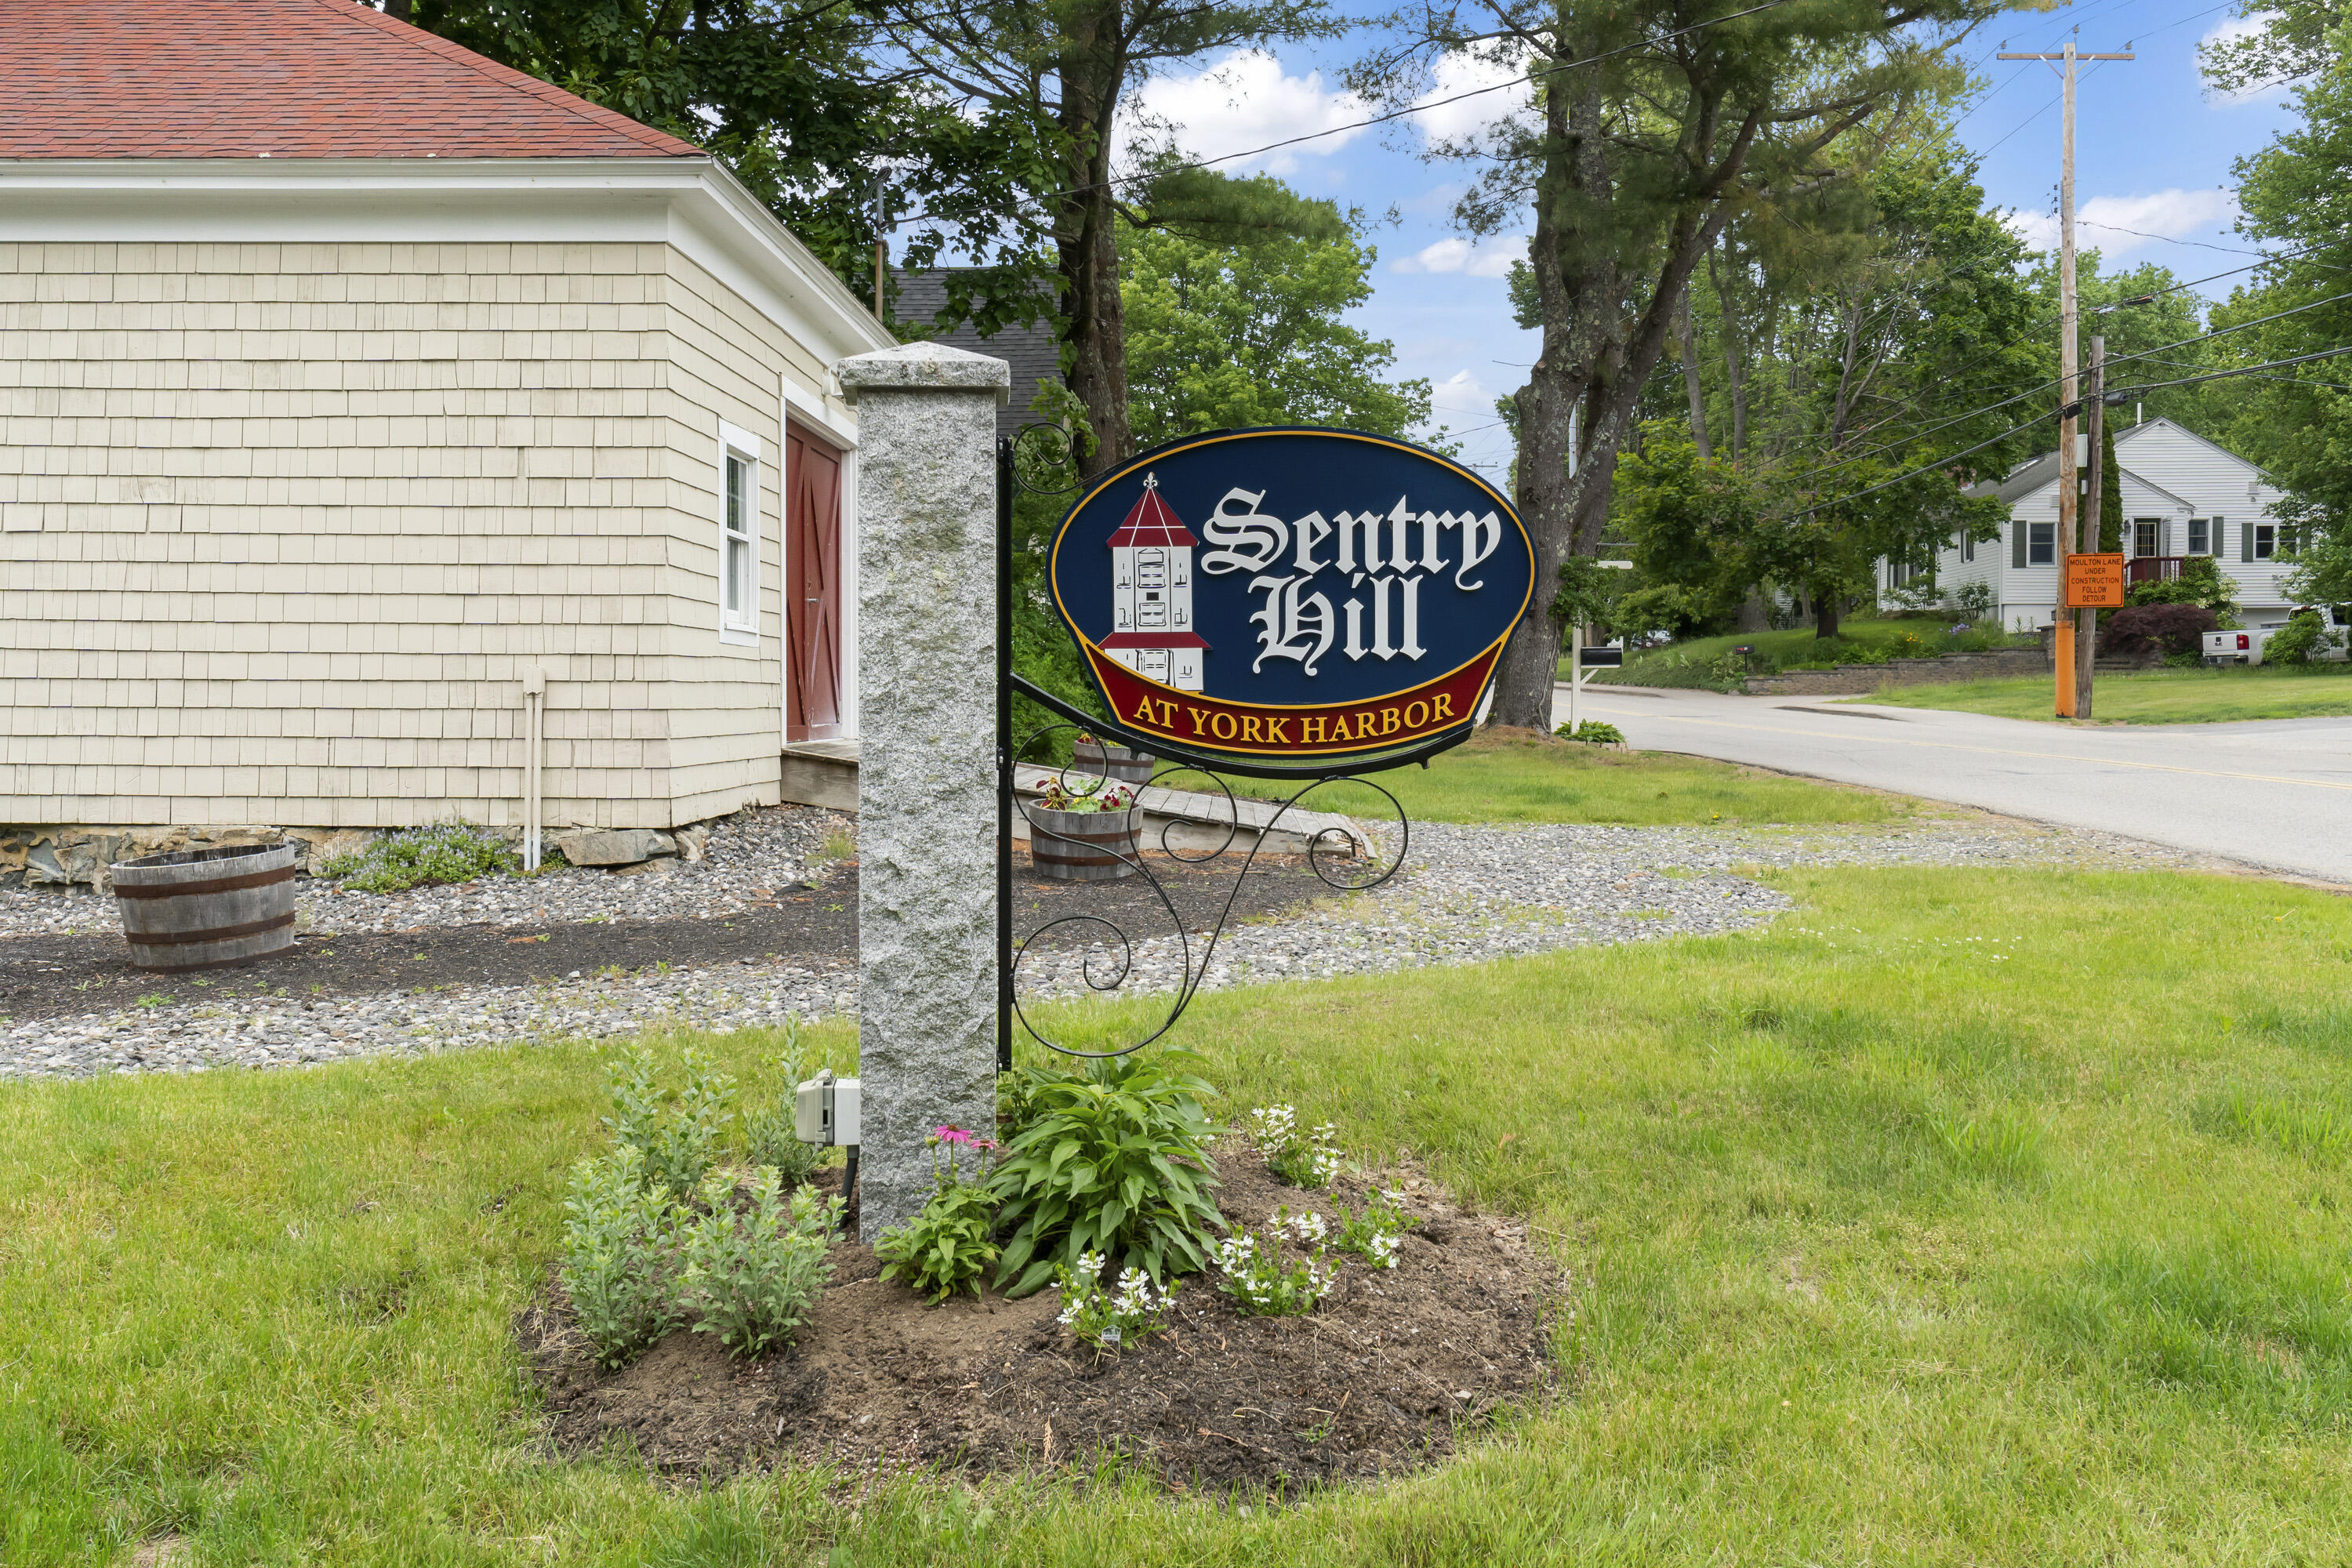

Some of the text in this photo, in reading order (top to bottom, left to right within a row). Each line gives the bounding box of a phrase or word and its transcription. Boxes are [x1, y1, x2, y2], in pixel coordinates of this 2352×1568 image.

[1200, 487, 1501, 590] Sentry
[1248, 572, 1428, 676] Hill
[1134, 693, 1454, 744] AT YORK HARBOR
